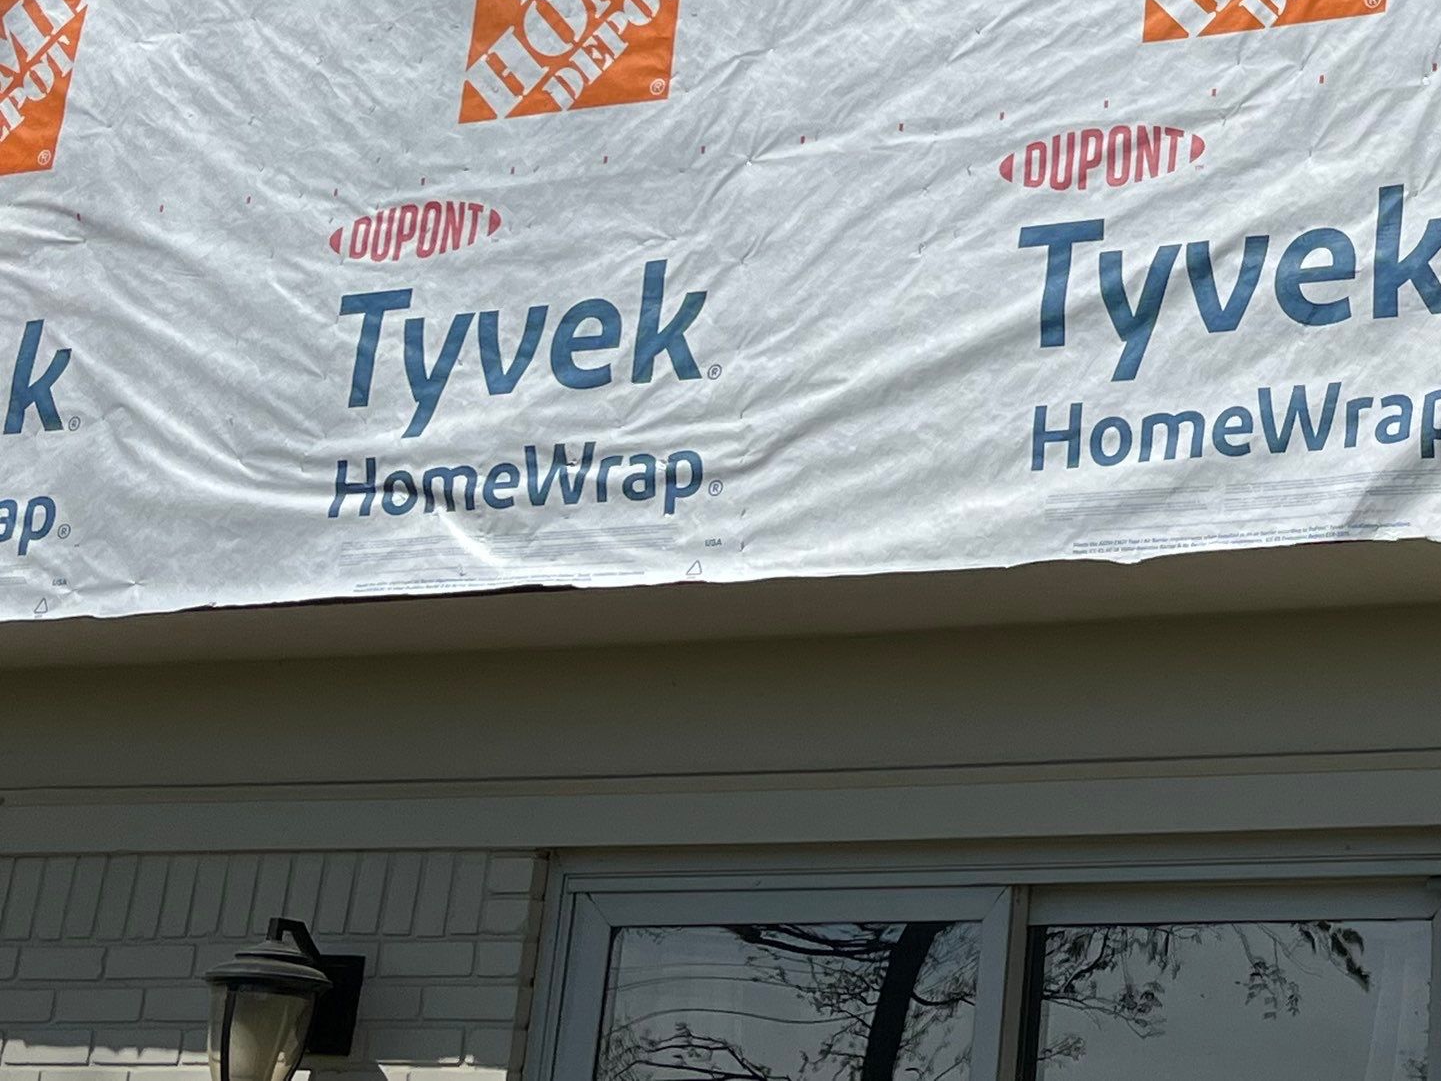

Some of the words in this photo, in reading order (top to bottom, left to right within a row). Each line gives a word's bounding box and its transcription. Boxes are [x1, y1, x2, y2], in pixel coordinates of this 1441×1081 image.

[1023, 125, 1185, 191] DUPONT
[348, 200, 484, 262] DUPONT
[339, 260, 708, 438] Tyvek
[328, 442, 703, 519] HomeWrap
